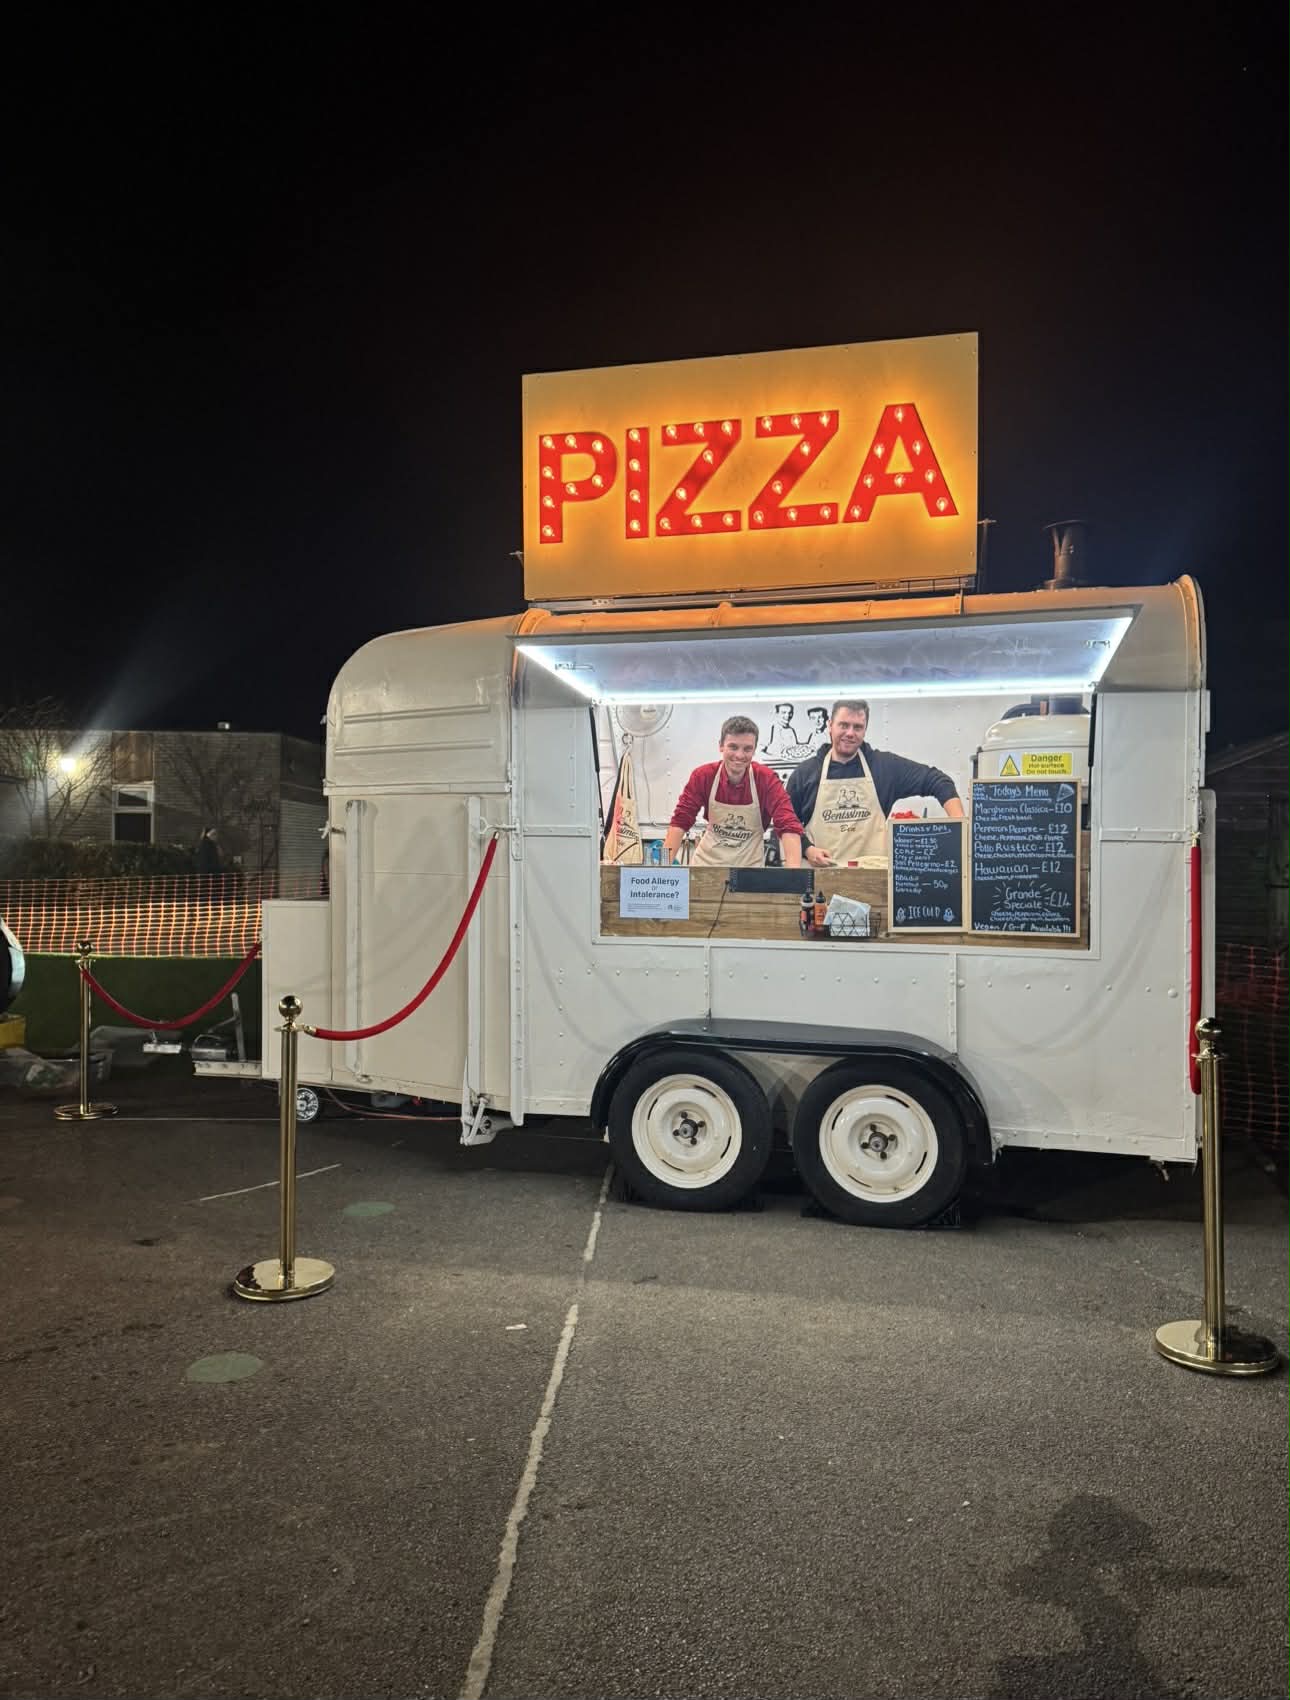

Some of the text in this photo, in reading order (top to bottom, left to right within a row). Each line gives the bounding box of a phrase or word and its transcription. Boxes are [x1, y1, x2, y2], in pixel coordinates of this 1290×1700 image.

[539, 402, 959, 544] PIZZA
[1030, 754, 1063, 763] Danger
[1025, 784, 1049, 797] Menu
[1055, 802, 1073, 814] £10
[1048, 823, 1069, 834] £12
[1045, 841, 1067, 853] £12
[631, 877, 680, 886] Food Allergy
[630, 890, 680, 898] Intolerance?
